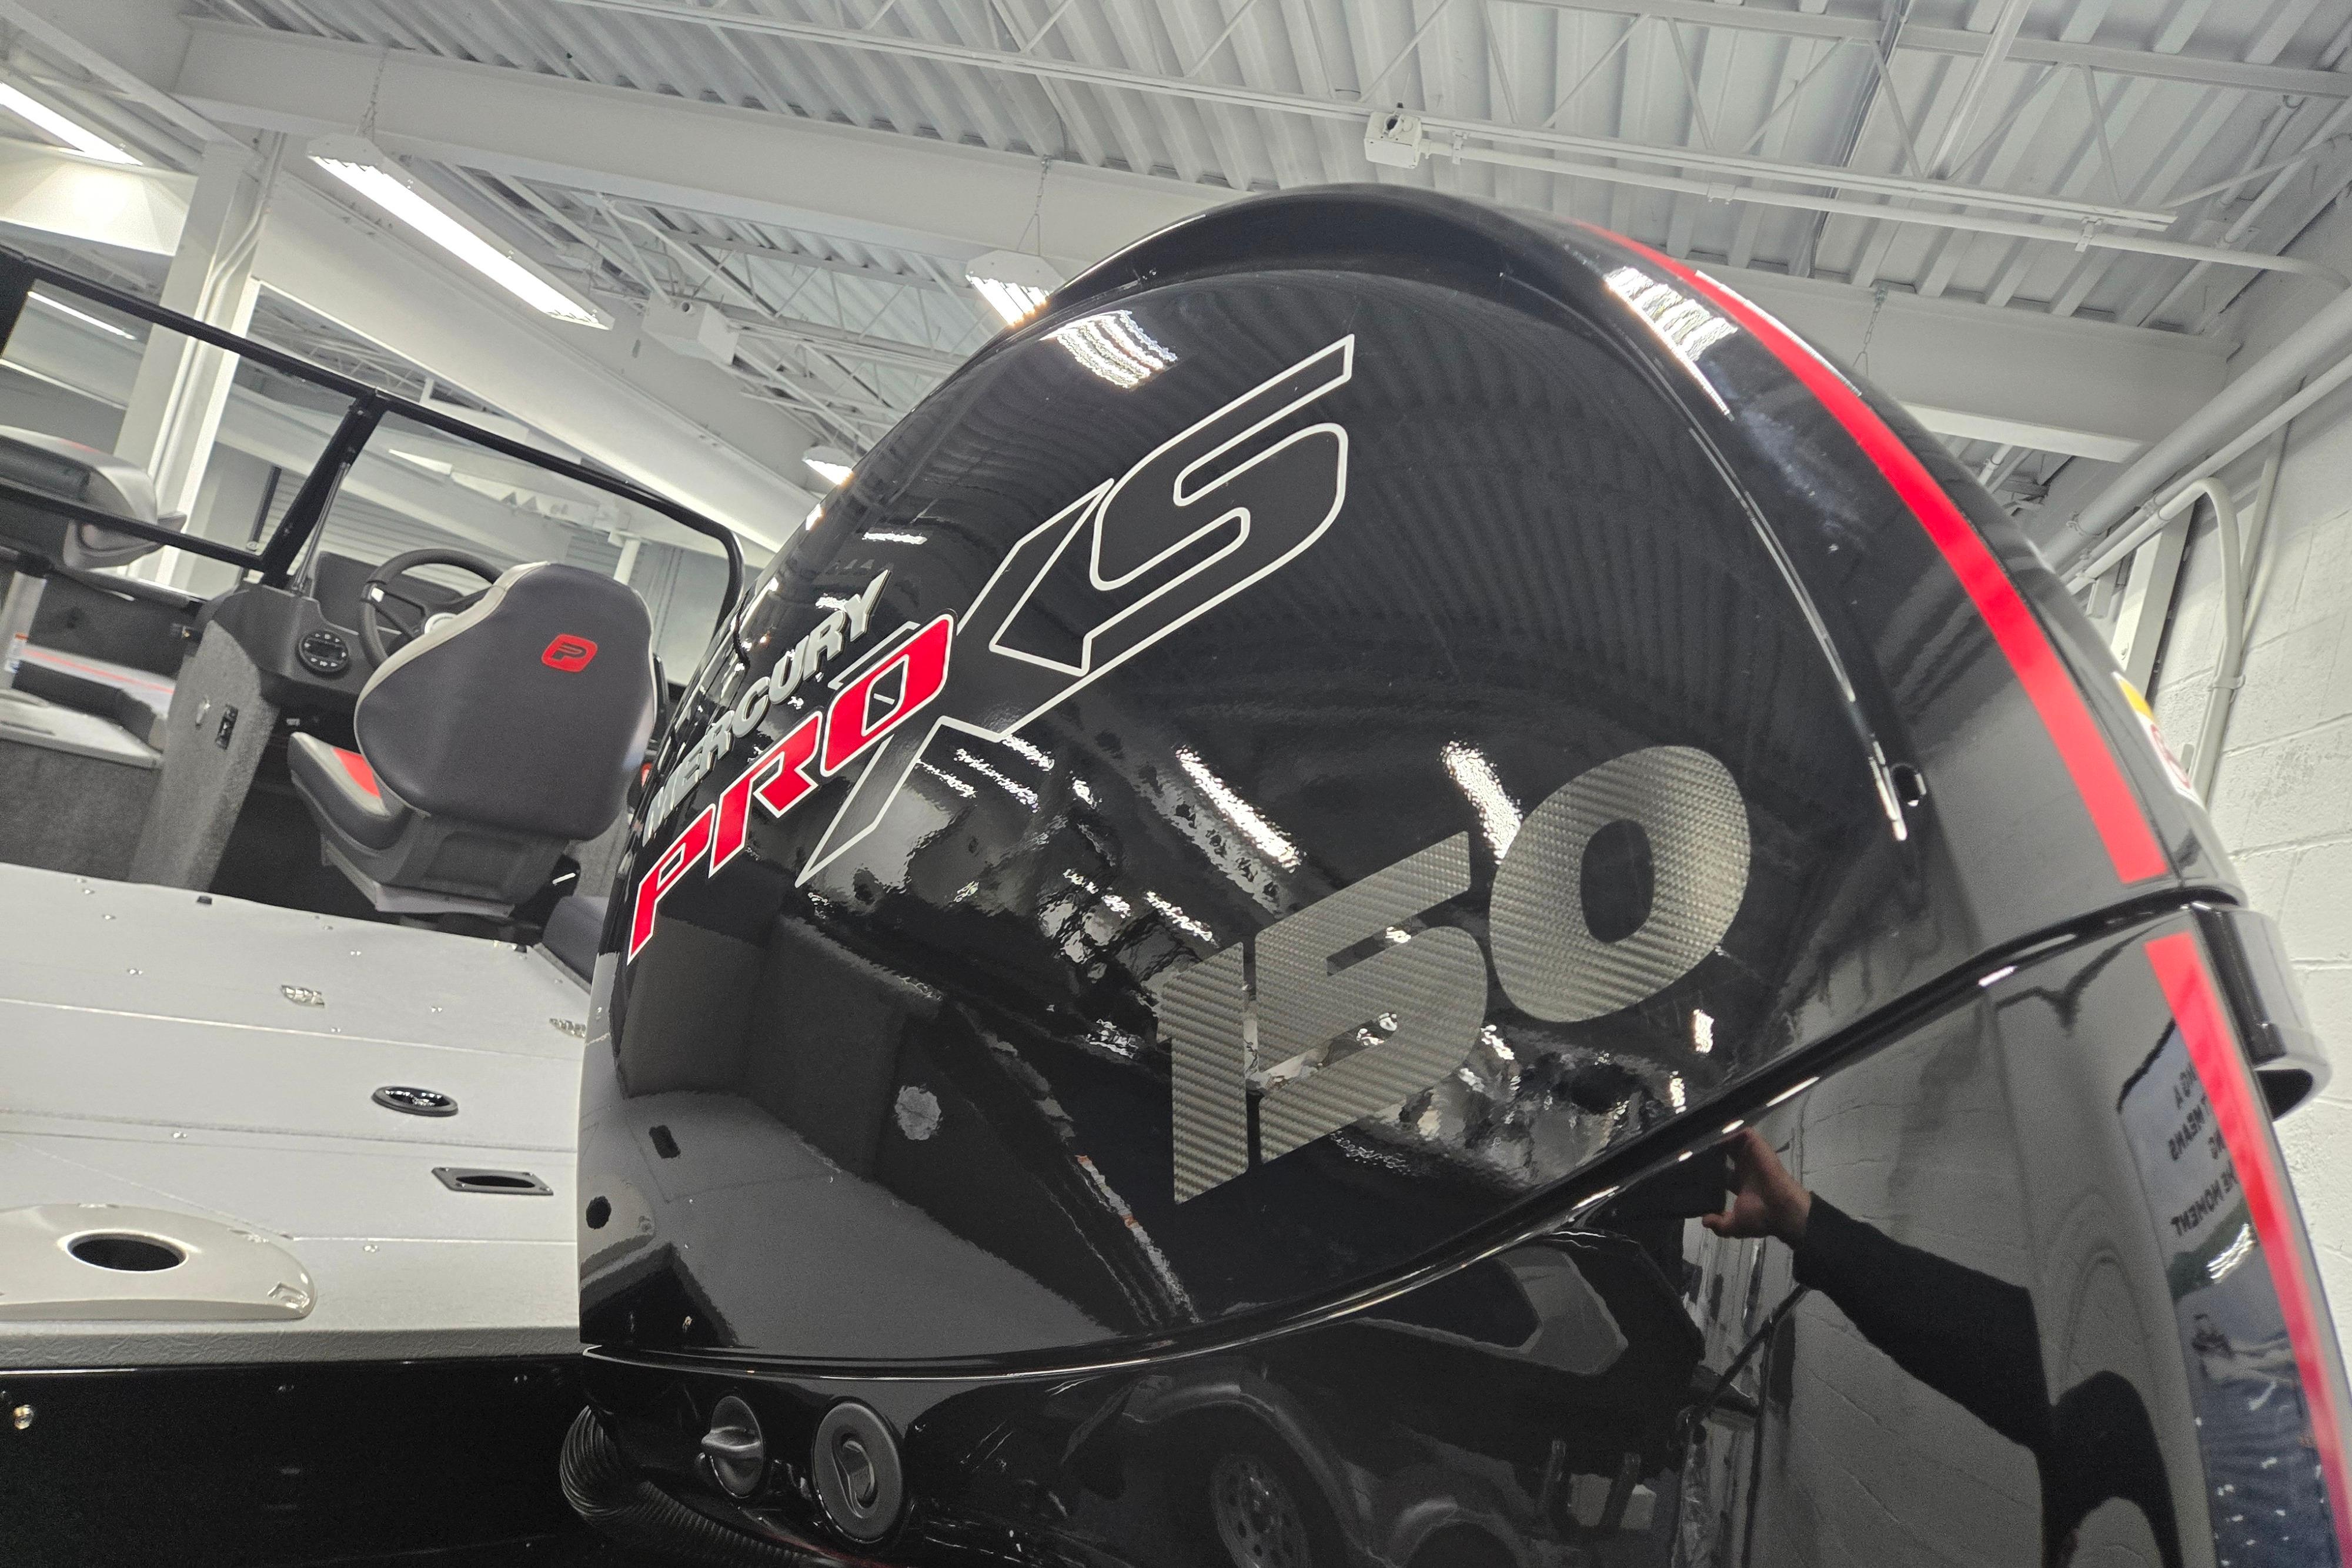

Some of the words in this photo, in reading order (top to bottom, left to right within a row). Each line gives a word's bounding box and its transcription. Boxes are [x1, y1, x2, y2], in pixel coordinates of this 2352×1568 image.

[627, 613, 955, 966] PRO
[795, 333, 1355, 887] XS
[643, 569, 890, 847] MERCURY
[1157, 745, 1751, 1205] 150
